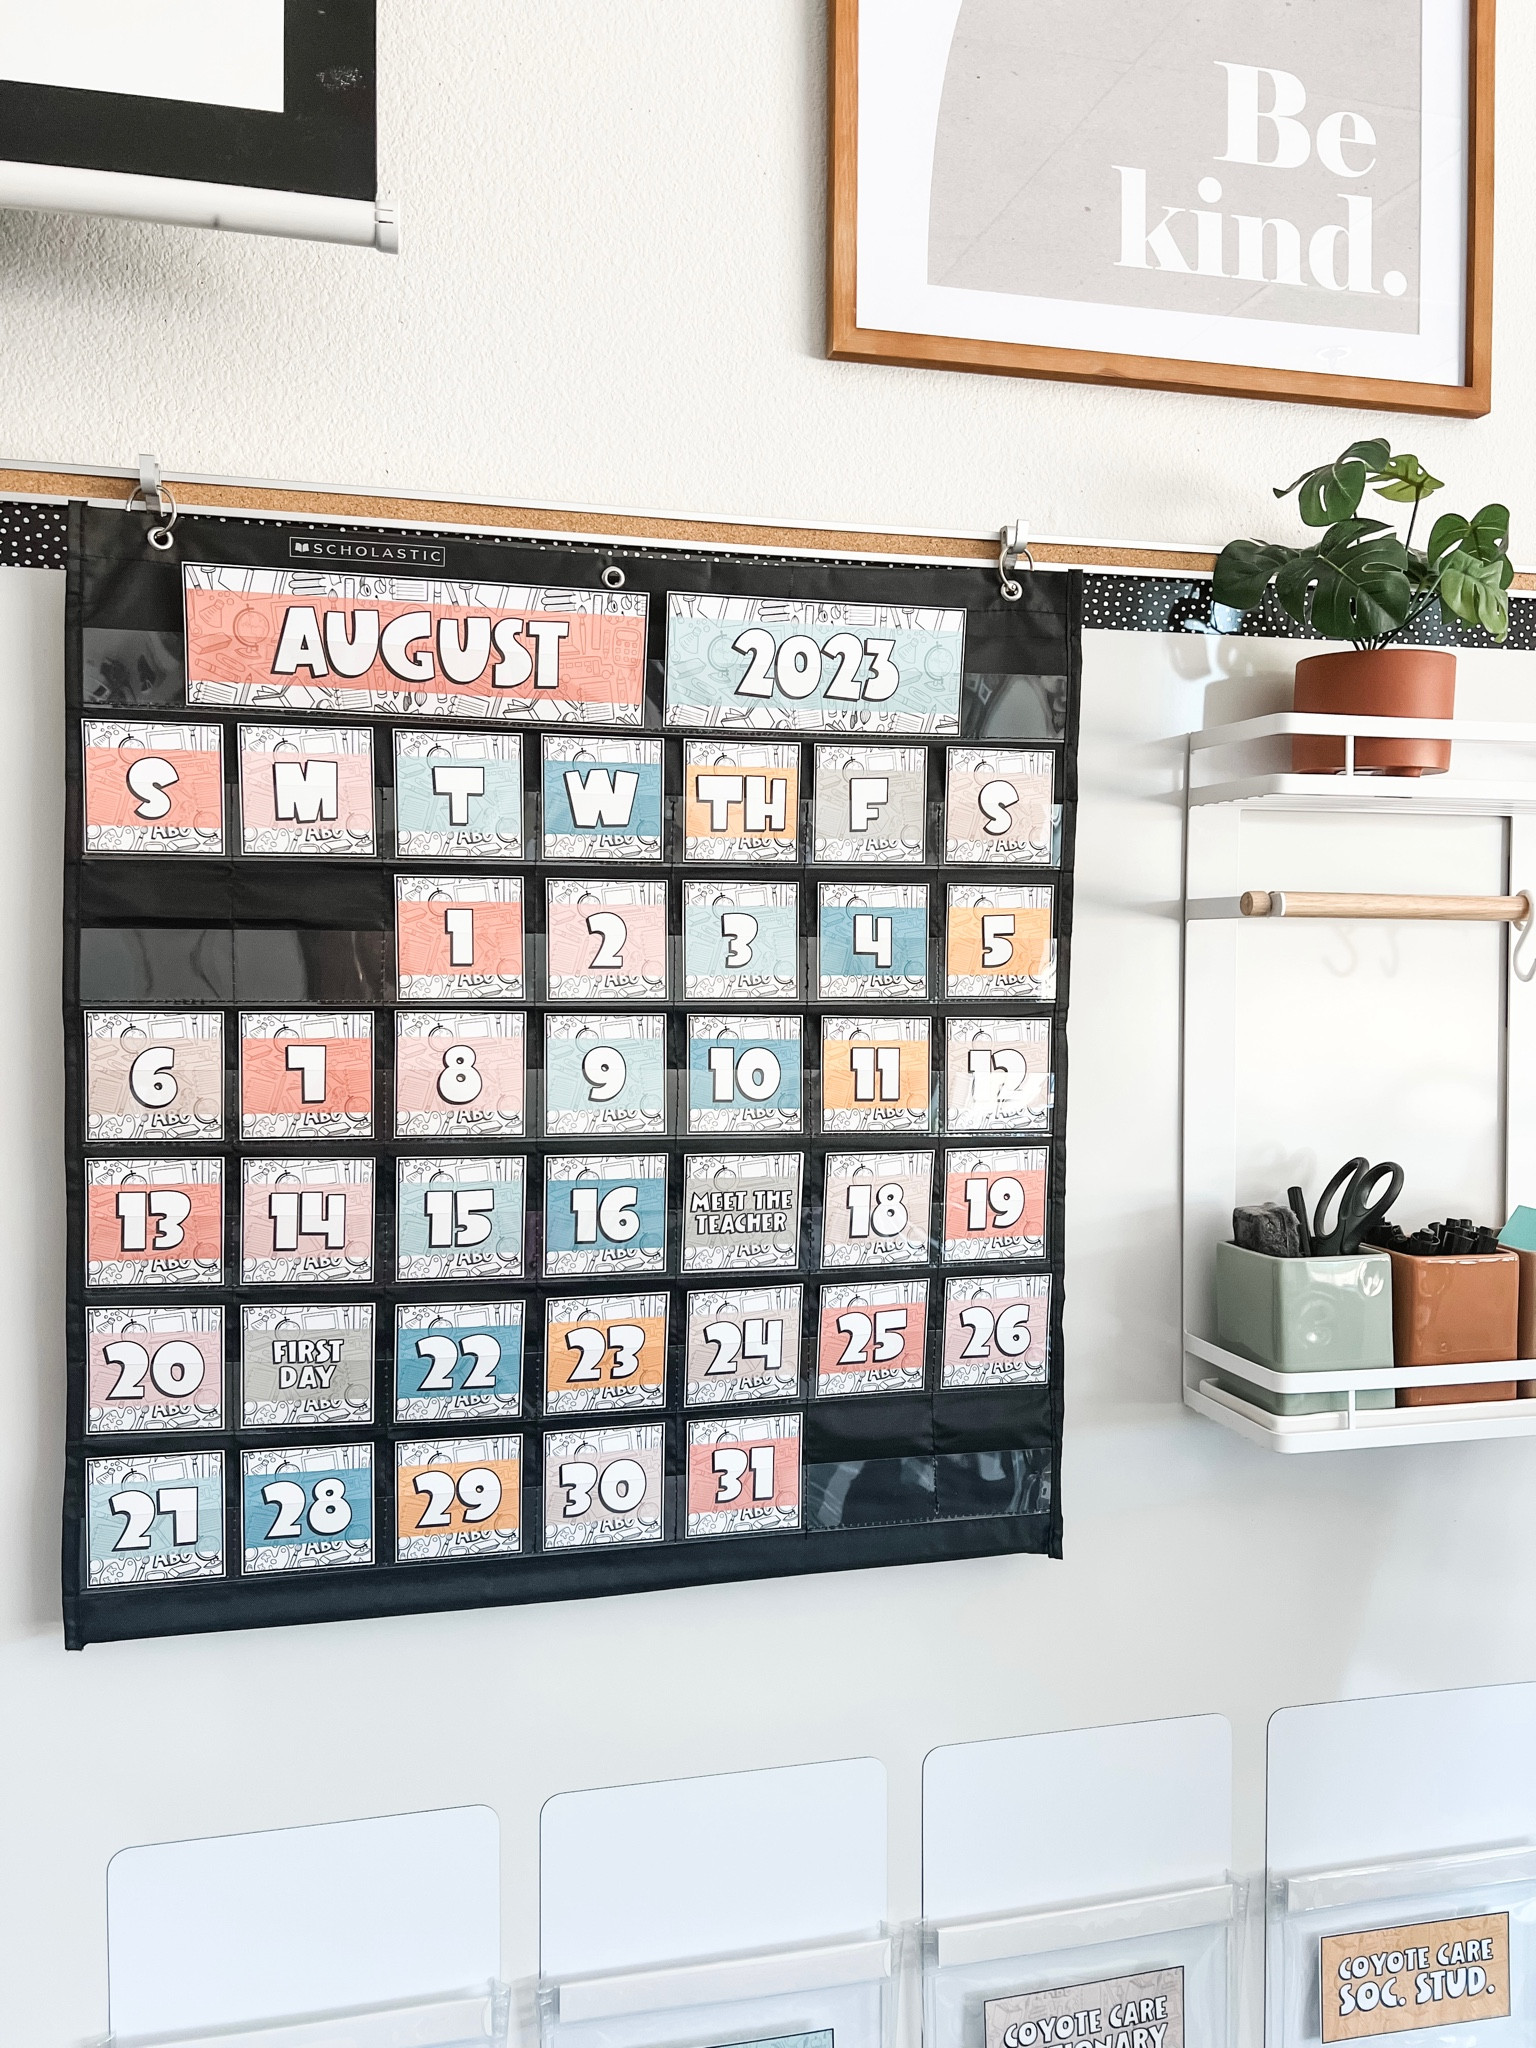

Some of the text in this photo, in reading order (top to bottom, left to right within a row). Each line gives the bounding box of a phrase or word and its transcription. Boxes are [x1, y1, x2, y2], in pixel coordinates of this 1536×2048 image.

[1213, 60, 1377, 178] Be
[1111, 165, 1407, 298] kind.
[313, 542, 441, 562] SCHOLASTIC
[271, 606, 569, 690] AUGUST
[732, 627, 900, 701] 2023
[126, 757, 179, 820] S
[273, 759, 338, 823] M
[432, 766, 485, 826] T
[563, 768, 640, 828] W
[696, 774, 787, 832] TH
[849, 777, 889, 832] F
[977, 780, 1019, 835] S
[445, 908, 473, 966] 1
[586, 912, 627, 969] 2
[721, 913, 758, 968] 3
[854, 914, 892, 968] 4
[981, 914, 1016, 968] 5
[130, 1046, 178, 1108] 6
[285, 1044, 326, 1103] 7
[437, 1045, 482, 1105] 8
[581, 1046, 626, 1102] 9
[708, 1046, 781, 1102] 10
[850, 1047, 900, 1101] 11
[968, 1048, 1027, 1102] 12
[116, 1190, 191, 1251] 13
[269, 1192, 346, 1251] 14
[424, 1188, 494, 1248] 15
[572, 1185, 640, 1244] 16
[690, 1190, 792, 1213] MEET THE
[695, 1214, 786, 1235] TEACHER
[848, 1183, 908, 1238] 18
[964, 1176, 1025, 1231] 19
[272, 1339, 344, 1364] FIRST
[565, 1324, 645, 1383] 23
[703, 1319, 783, 1376] 24
[837, 1309, 908, 1365] 25
[961, 1304, 1031, 1359] 26
[104, 1340, 205, 1400] 20
[279, 1366, 336, 1389] DAY
[416, 1334, 501, 1391] 22
[414, 1467, 502, 1529] 29
[560, 1459, 646, 1518] 30
[713, 1446, 774, 1503] 31
[110, 1487, 199, 1552] 27
[263, 1478, 352, 1540] 28
[1337, 1937, 1494, 1982] COYOTE CARE
[1337, 1964, 1496, 2017] SOC. STUD.
[1004, 2008, 1101, 2048] COYOTE
[1109, 1995, 1168, 2028] CARE
